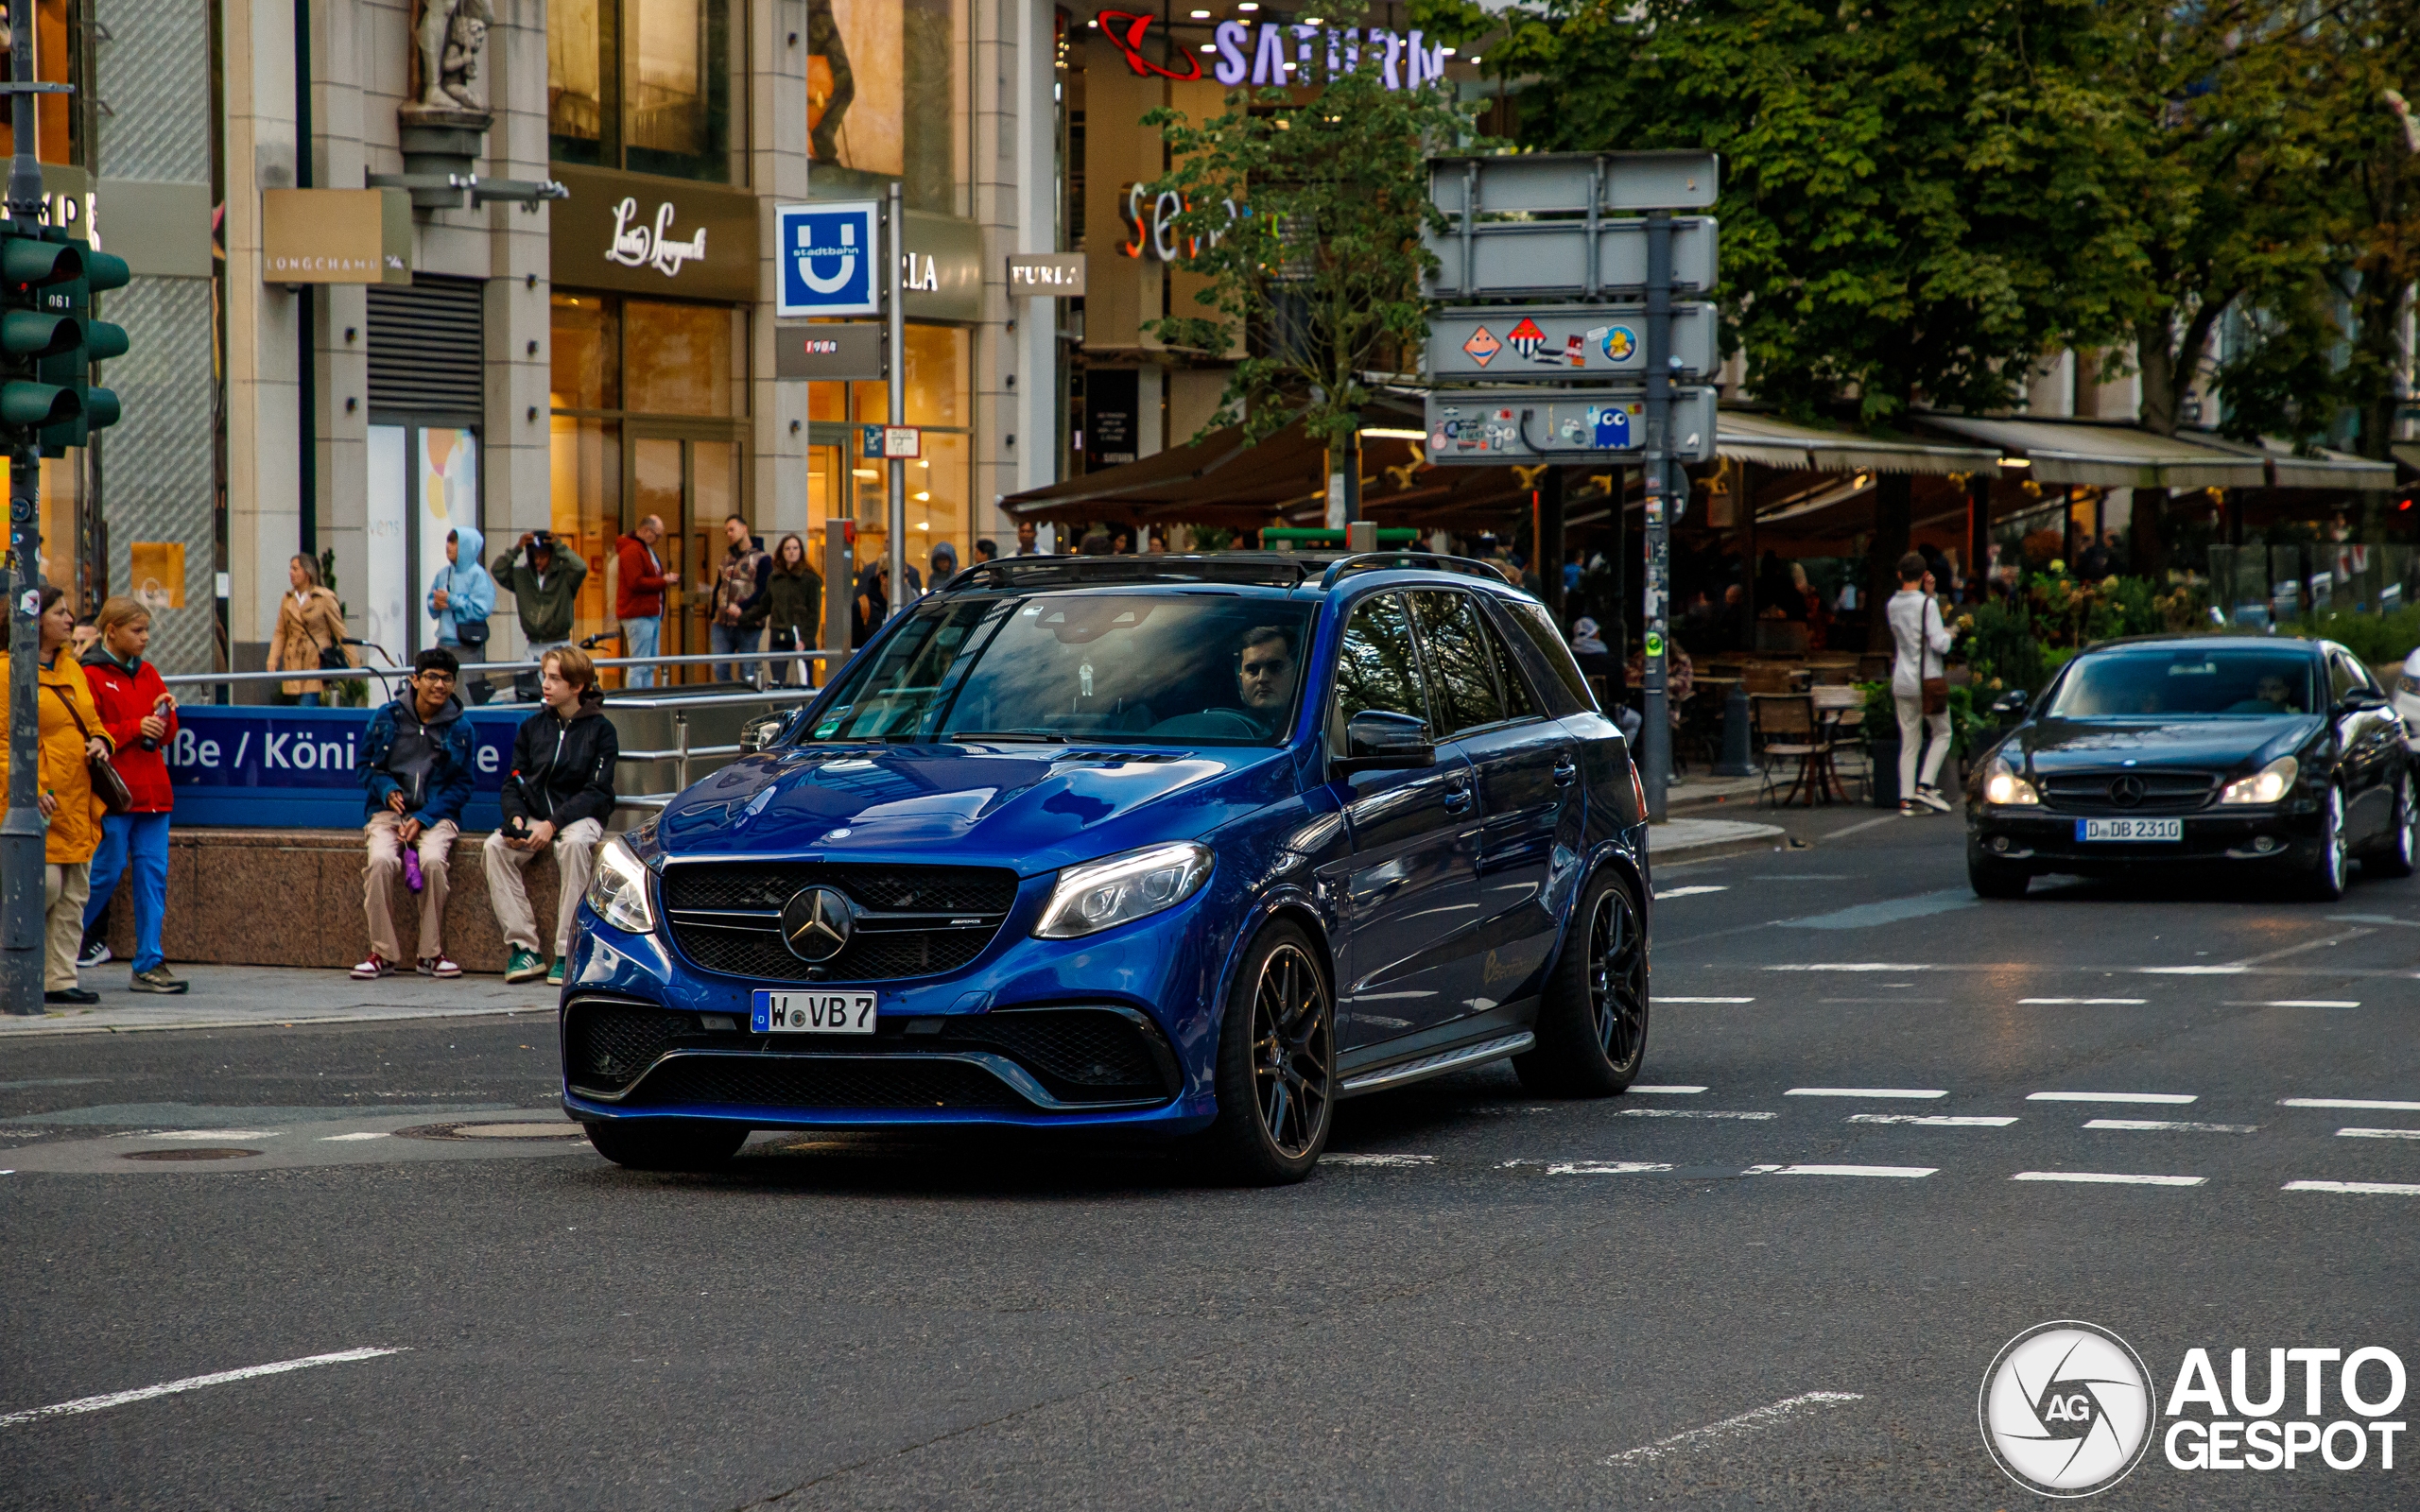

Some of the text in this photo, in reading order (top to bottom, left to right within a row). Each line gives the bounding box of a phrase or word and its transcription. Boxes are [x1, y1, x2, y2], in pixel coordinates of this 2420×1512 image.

[1214, 20, 1444, 91] SATURN
[793, 246, 859, 257] stadtbahn
[1011, 266, 1080, 284] FURLA
[48, 294, 71, 308] 061
[2088, 821, 2179, 837] D DB 2310
[757, 1015, 766, 1024] D
[770, 996, 873, 1028] W VB 7
